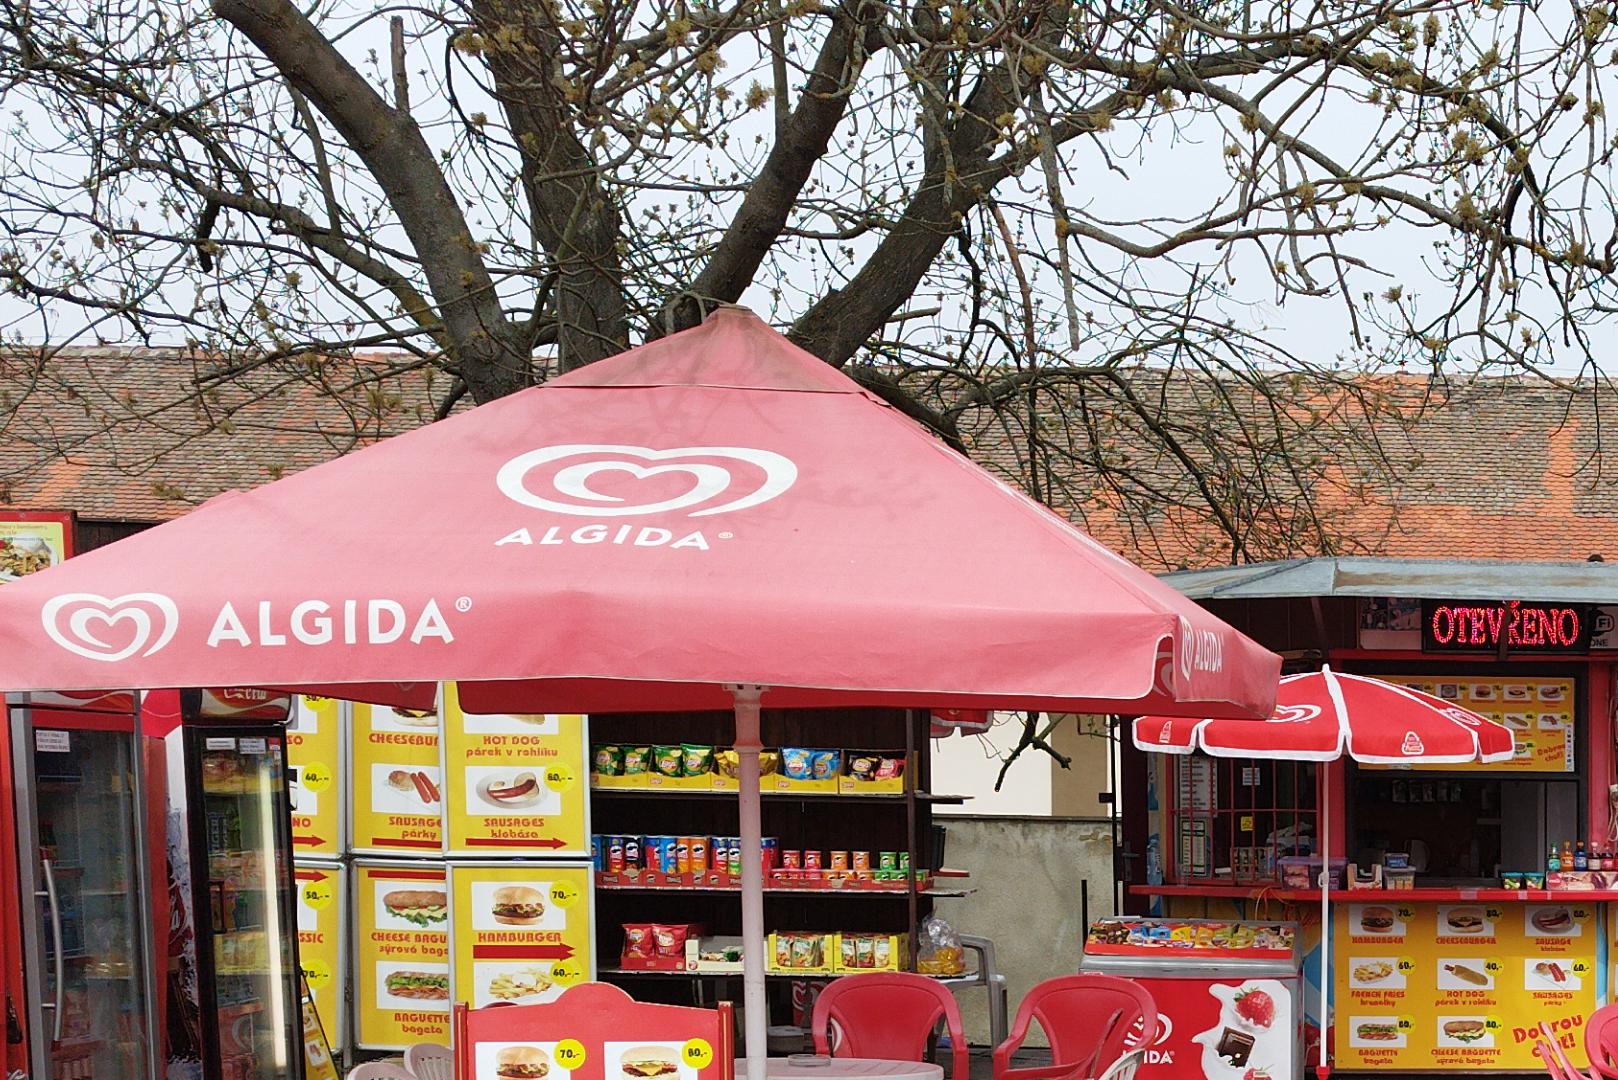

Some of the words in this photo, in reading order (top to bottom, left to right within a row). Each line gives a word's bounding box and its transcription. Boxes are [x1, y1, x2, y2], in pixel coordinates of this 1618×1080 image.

[494, 524, 709, 550] ALGIDA
[483, 736, 507, 746] HOT
[512, 736, 540, 746] DOG
[484, 818, 544, 828] SAUSAGES
[371, 933, 411, 943] CHEESE
[478, 932, 561, 943] HAMBURGER
